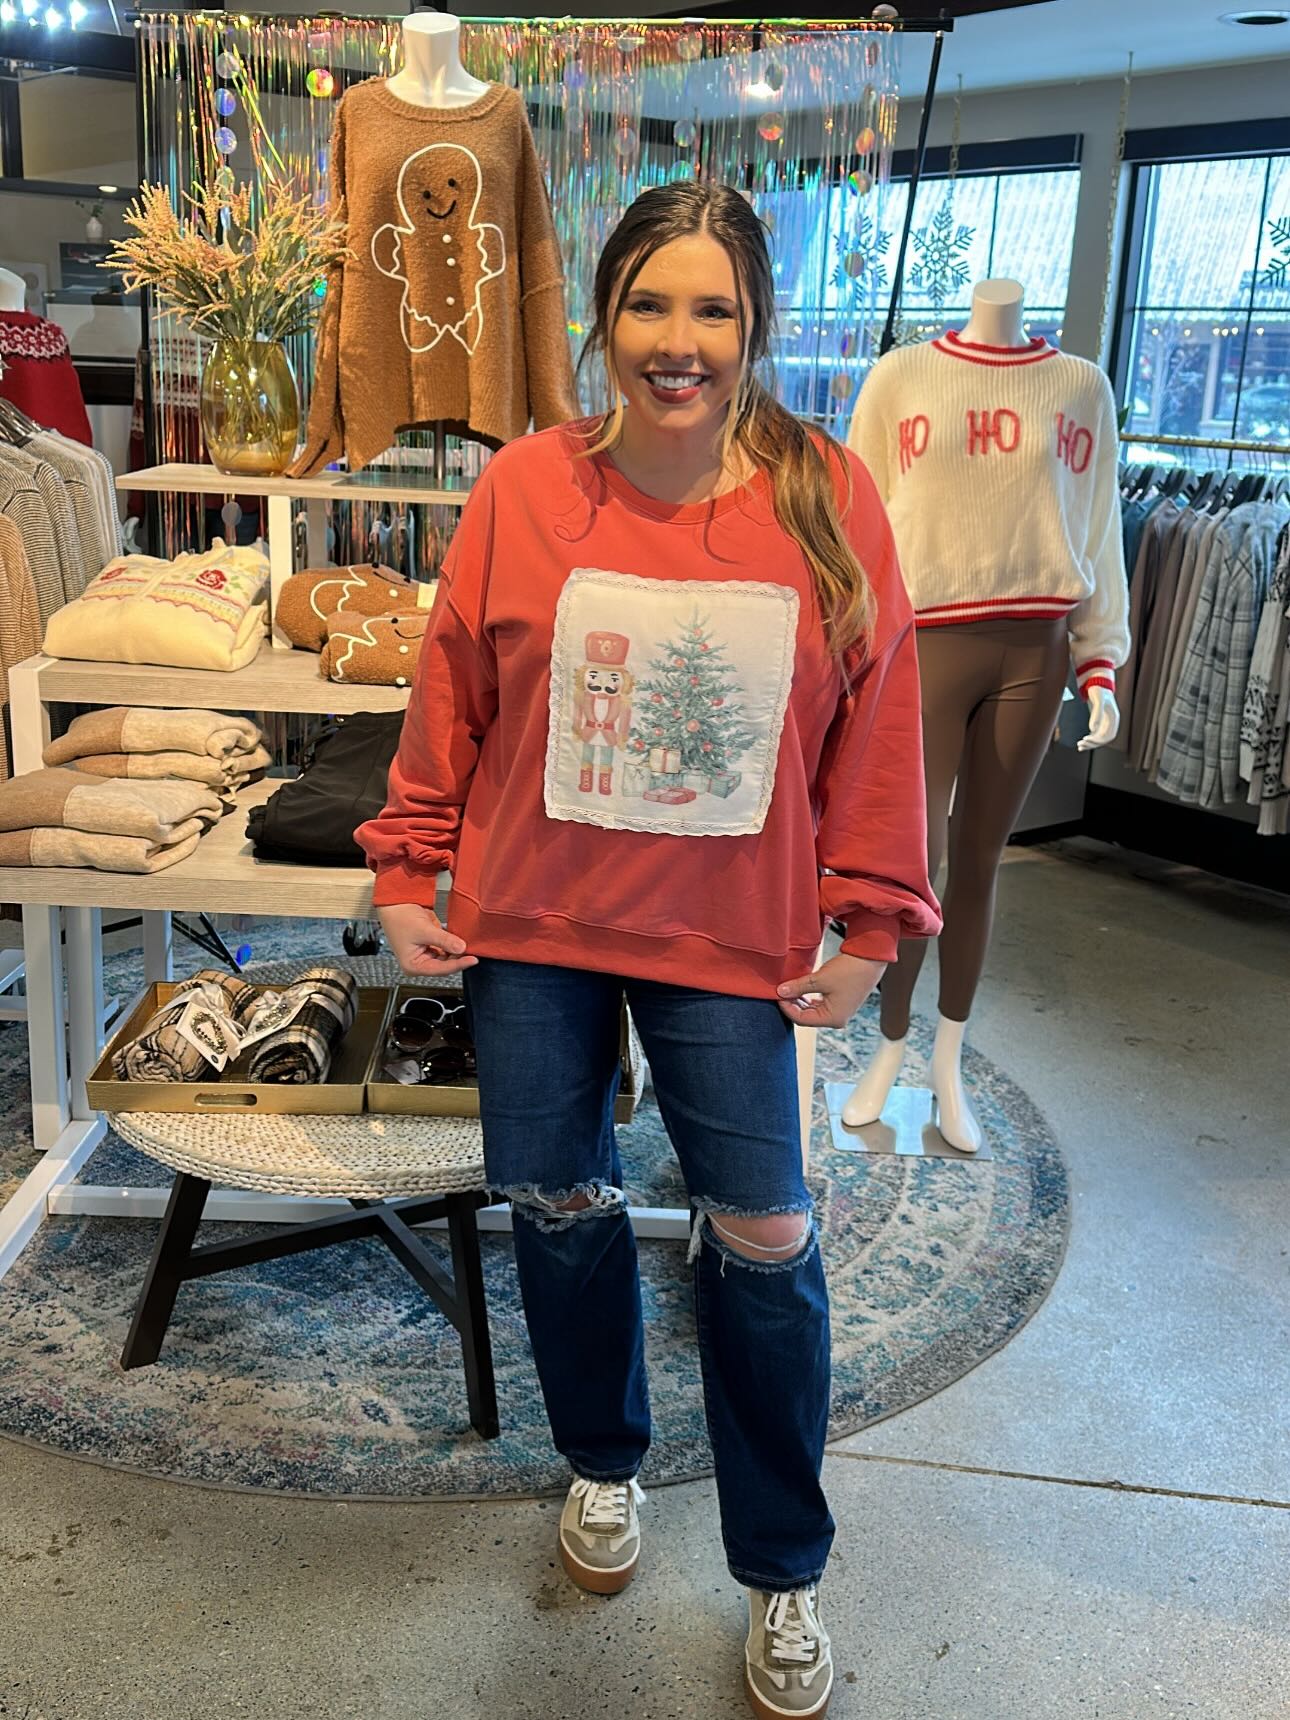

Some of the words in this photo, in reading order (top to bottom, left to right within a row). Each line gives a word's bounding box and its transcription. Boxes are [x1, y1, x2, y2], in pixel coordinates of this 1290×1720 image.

[898, 414, 930, 475] HO
[966, 408, 1021, 456] HO
[1056, 412, 1094, 474] HO
